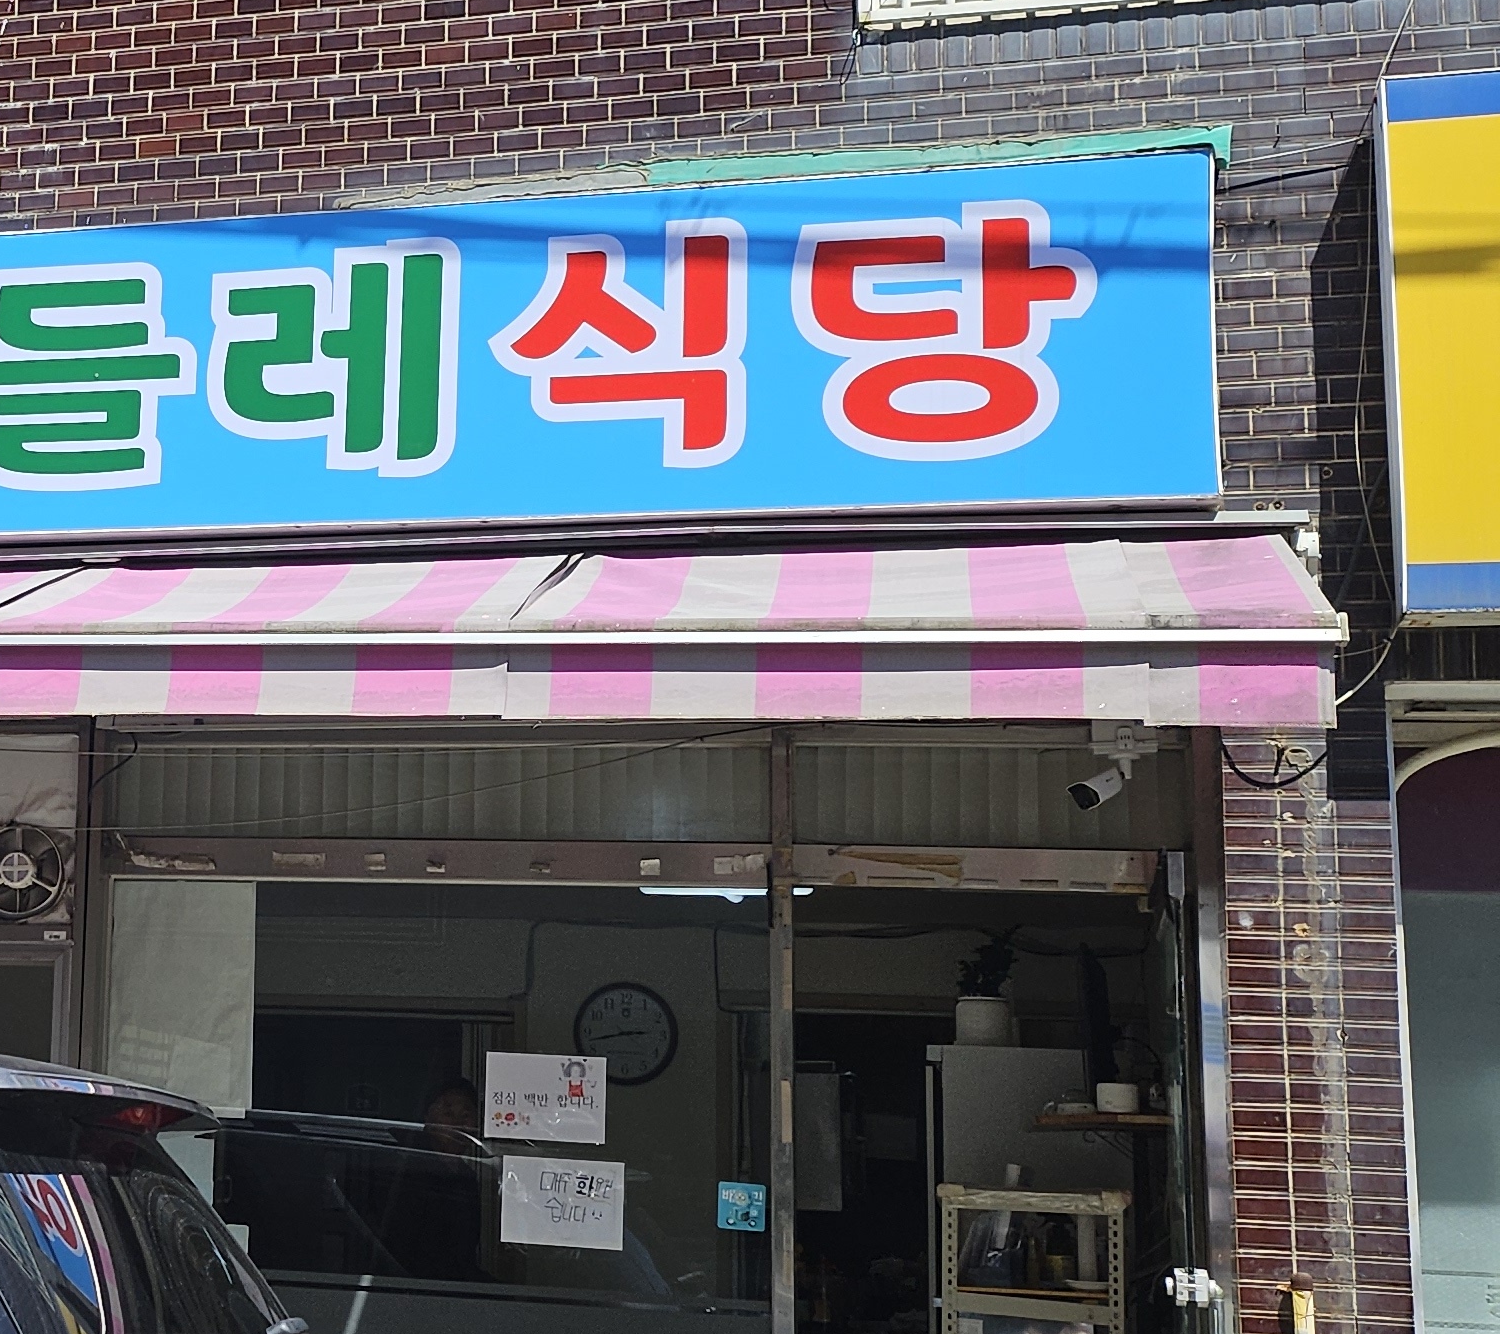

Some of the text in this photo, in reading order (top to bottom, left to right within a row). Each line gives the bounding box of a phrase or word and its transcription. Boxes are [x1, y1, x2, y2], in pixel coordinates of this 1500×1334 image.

[492, 1091, 599, 1109] 점심 백반 합니다.
[540, 1171, 573, 1194] 매주
